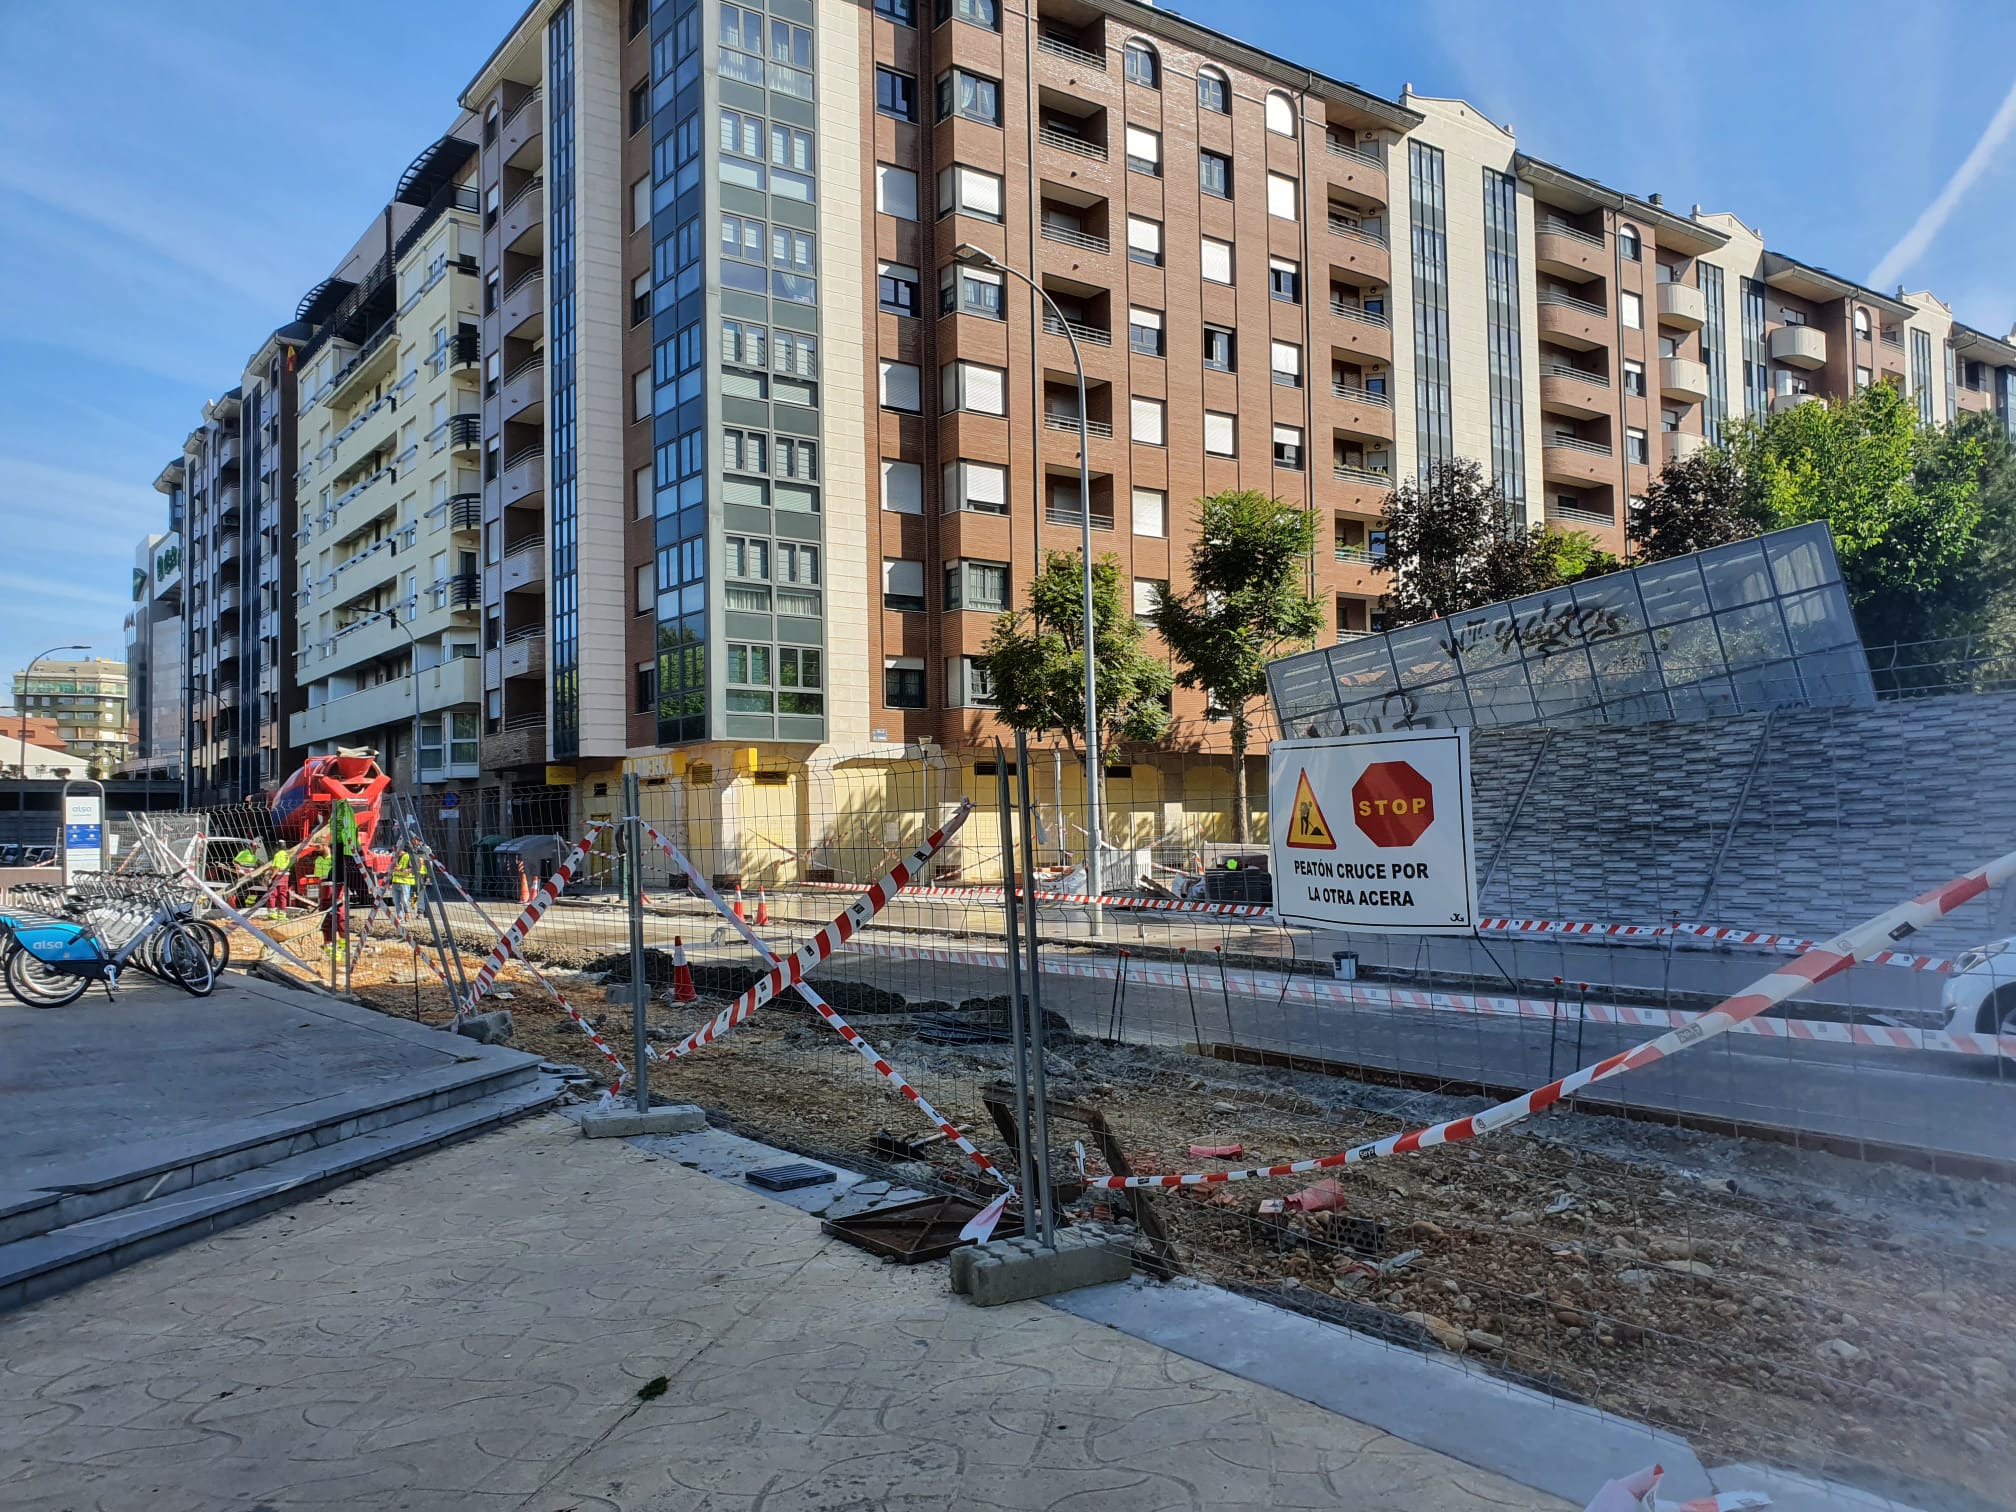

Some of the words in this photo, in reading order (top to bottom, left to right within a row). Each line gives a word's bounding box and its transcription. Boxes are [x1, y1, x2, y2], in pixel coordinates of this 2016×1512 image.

[1358, 797, 1427, 817] STOP
[1294, 858, 1334, 878] PEATÓN
[1336, 863, 1387, 879] CRUCE
[1391, 862, 1429, 879] POR
[1307, 885, 1321, 902] LA
[1322, 888, 1355, 905] OTRA
[1358, 890, 1415, 907] ACERA
[32, 940, 64, 950] alsa
